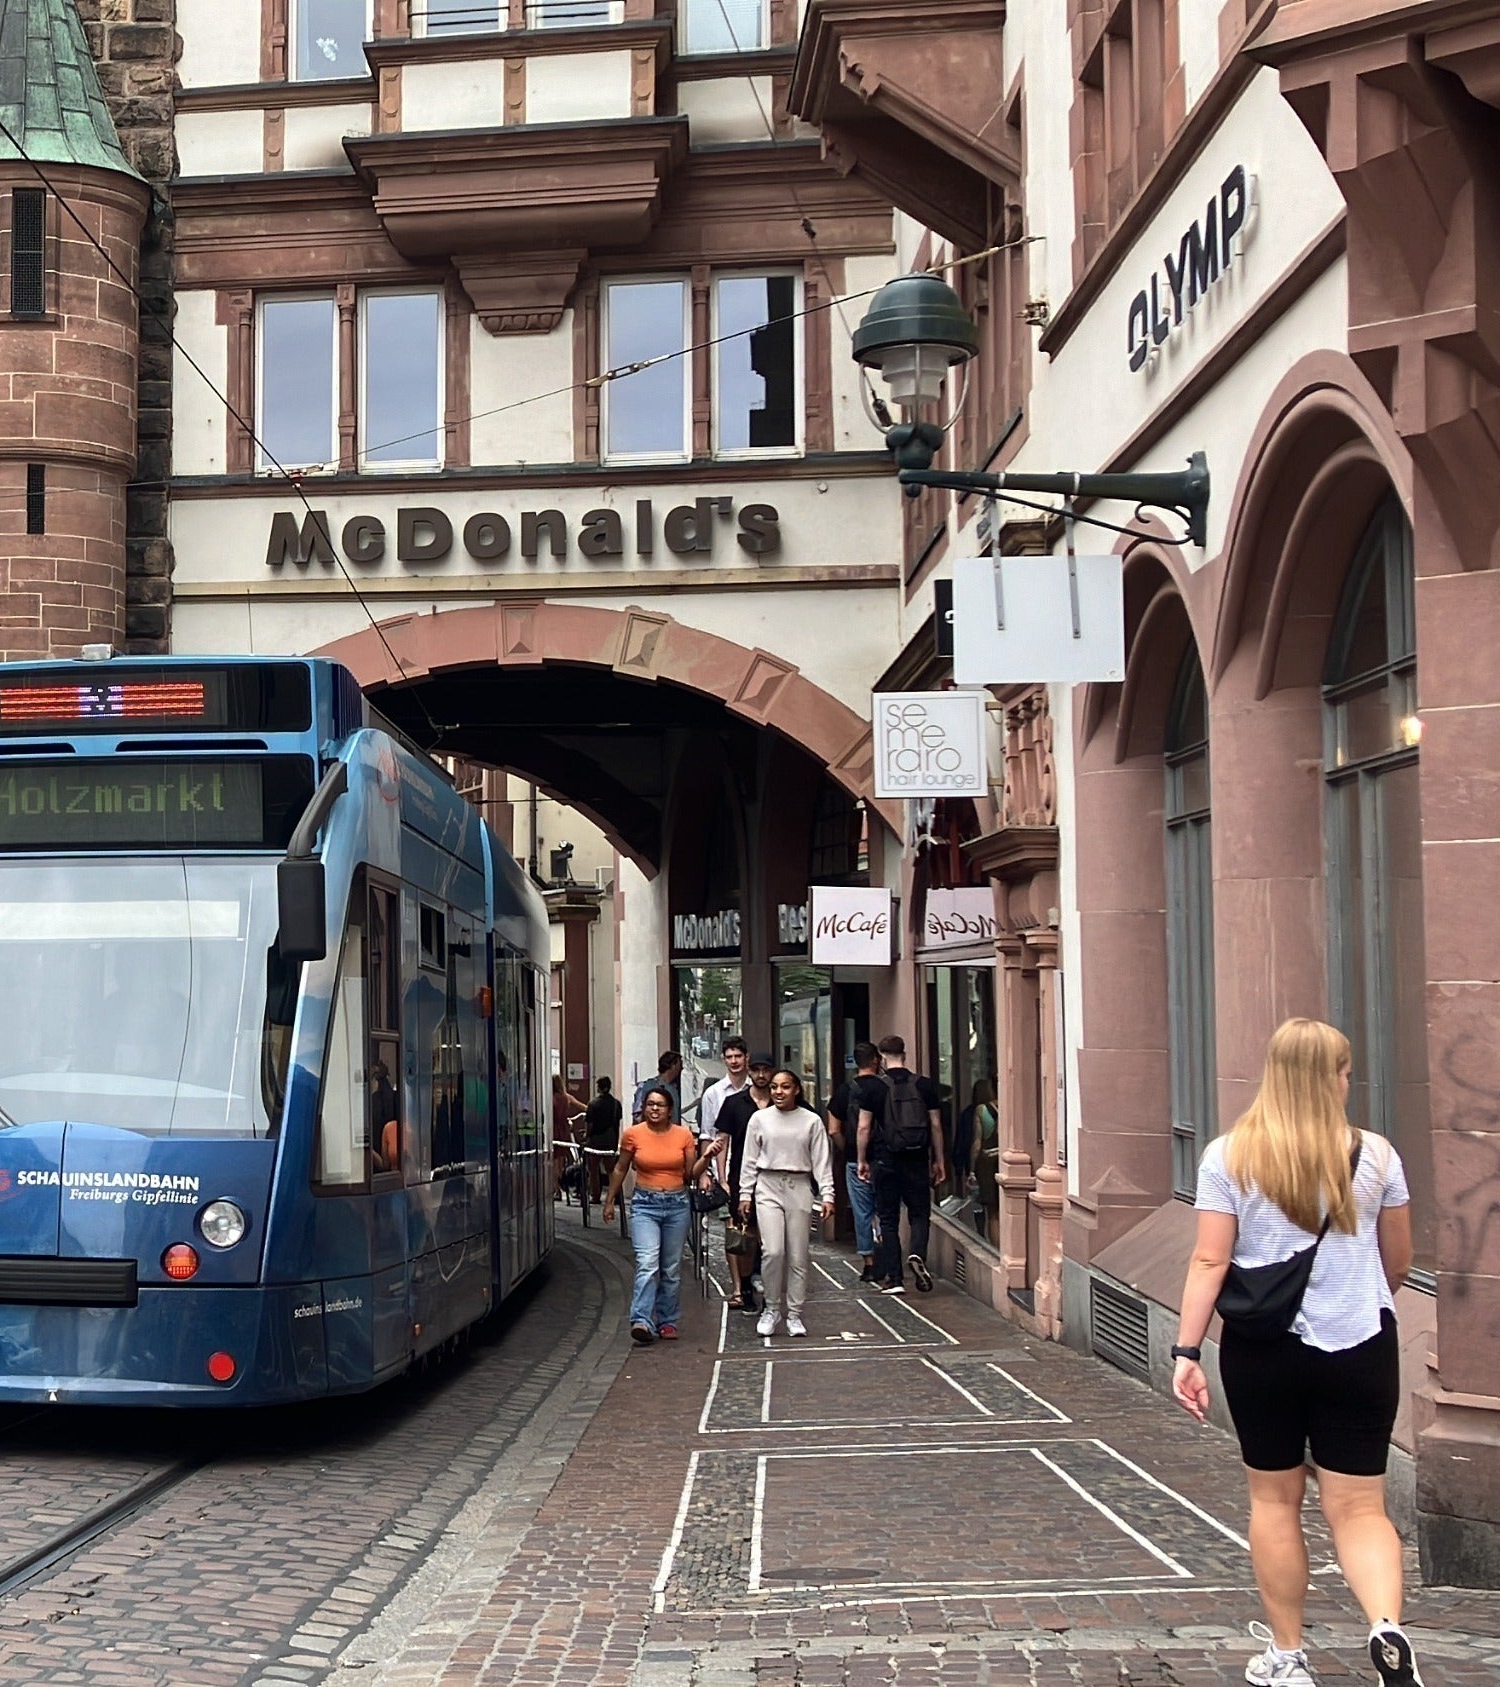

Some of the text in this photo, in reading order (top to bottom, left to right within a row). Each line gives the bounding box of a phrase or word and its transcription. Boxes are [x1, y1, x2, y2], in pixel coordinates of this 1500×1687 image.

[1128, 164, 1246, 373] OLYMP
[266, 496, 782, 565] McDonald's
[887, 772, 975, 788] hair lounge
[816, 911, 888, 940] McCafé
[17, 1170, 200, 1191] SCHAUINSLANDBAHN
[69, 1188, 199, 1205] Freiburgs Gipfellinie
